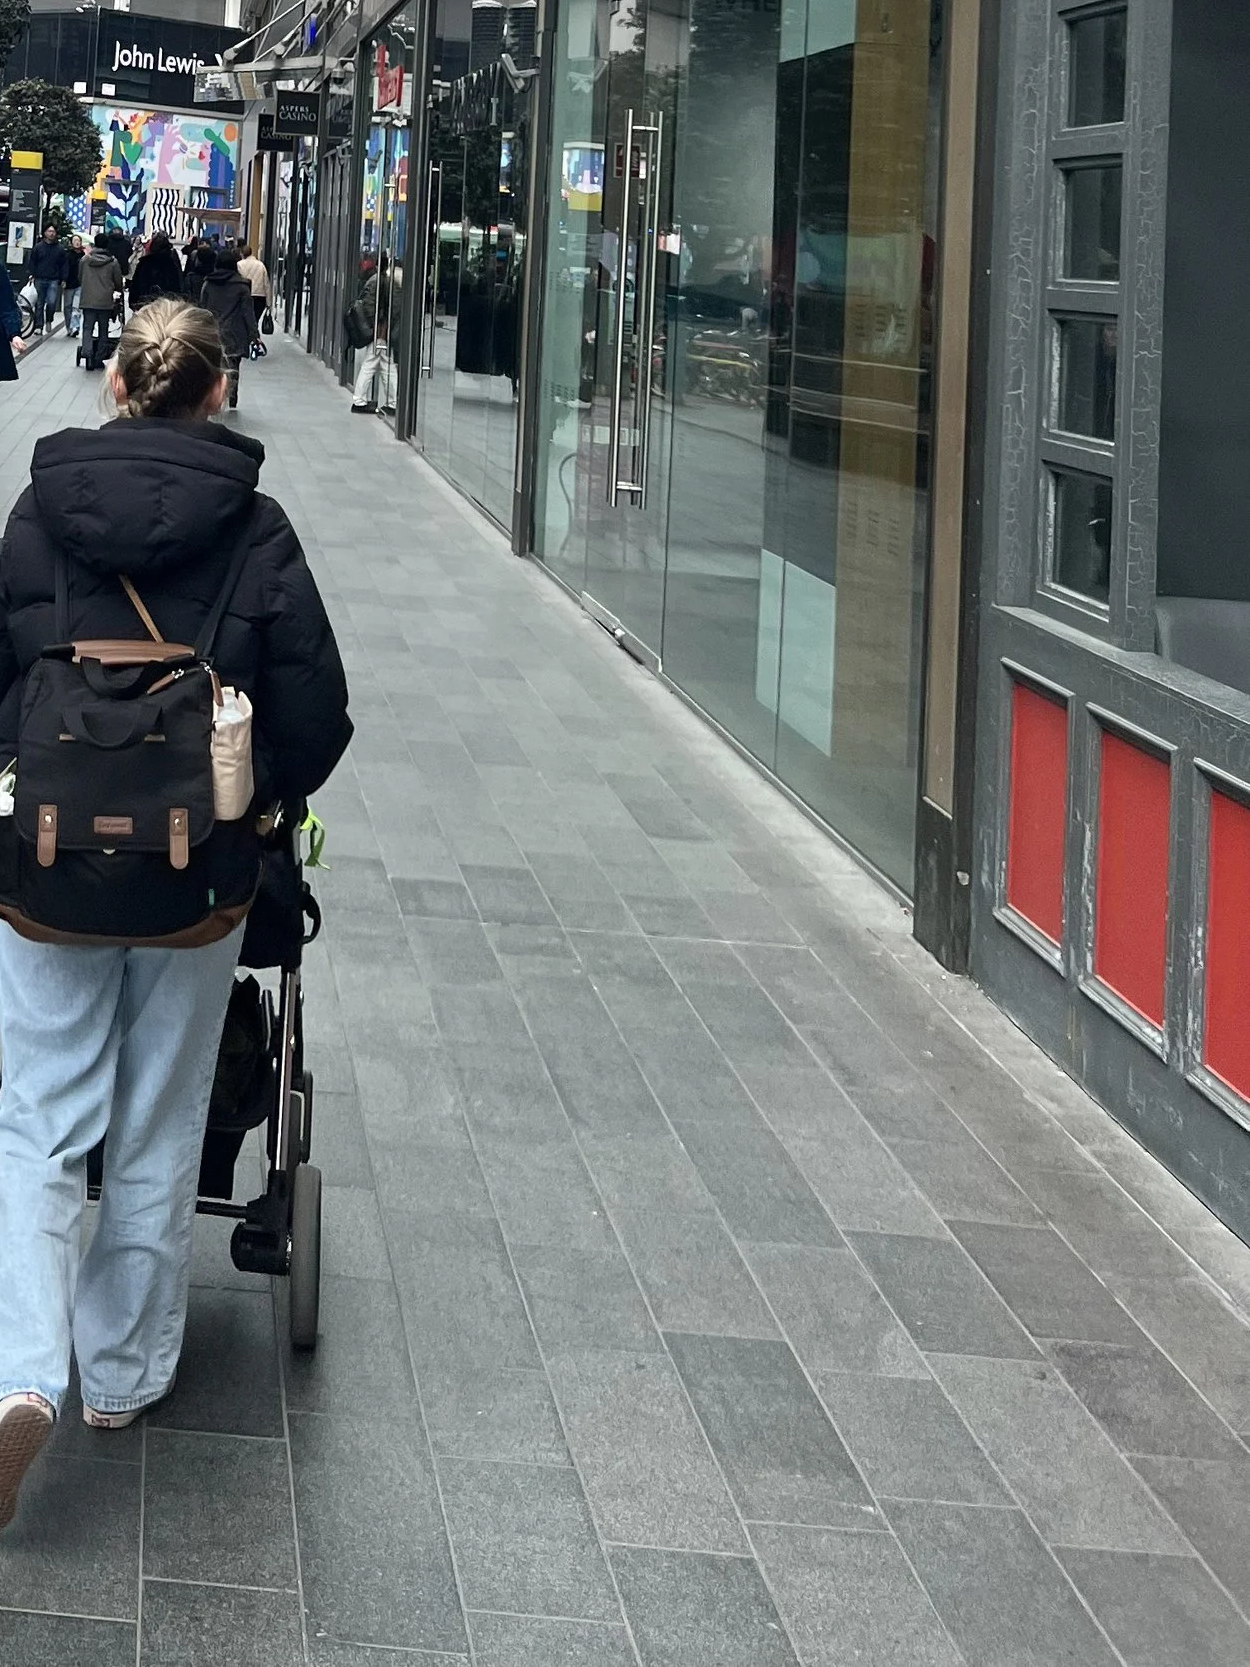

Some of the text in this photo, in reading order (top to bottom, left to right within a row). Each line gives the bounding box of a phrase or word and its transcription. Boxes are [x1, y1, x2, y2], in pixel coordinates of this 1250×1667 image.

[111, 39, 155, 73] John
[280, 105, 310, 113] ASPERS
[279, 112, 317, 122] CASINO
